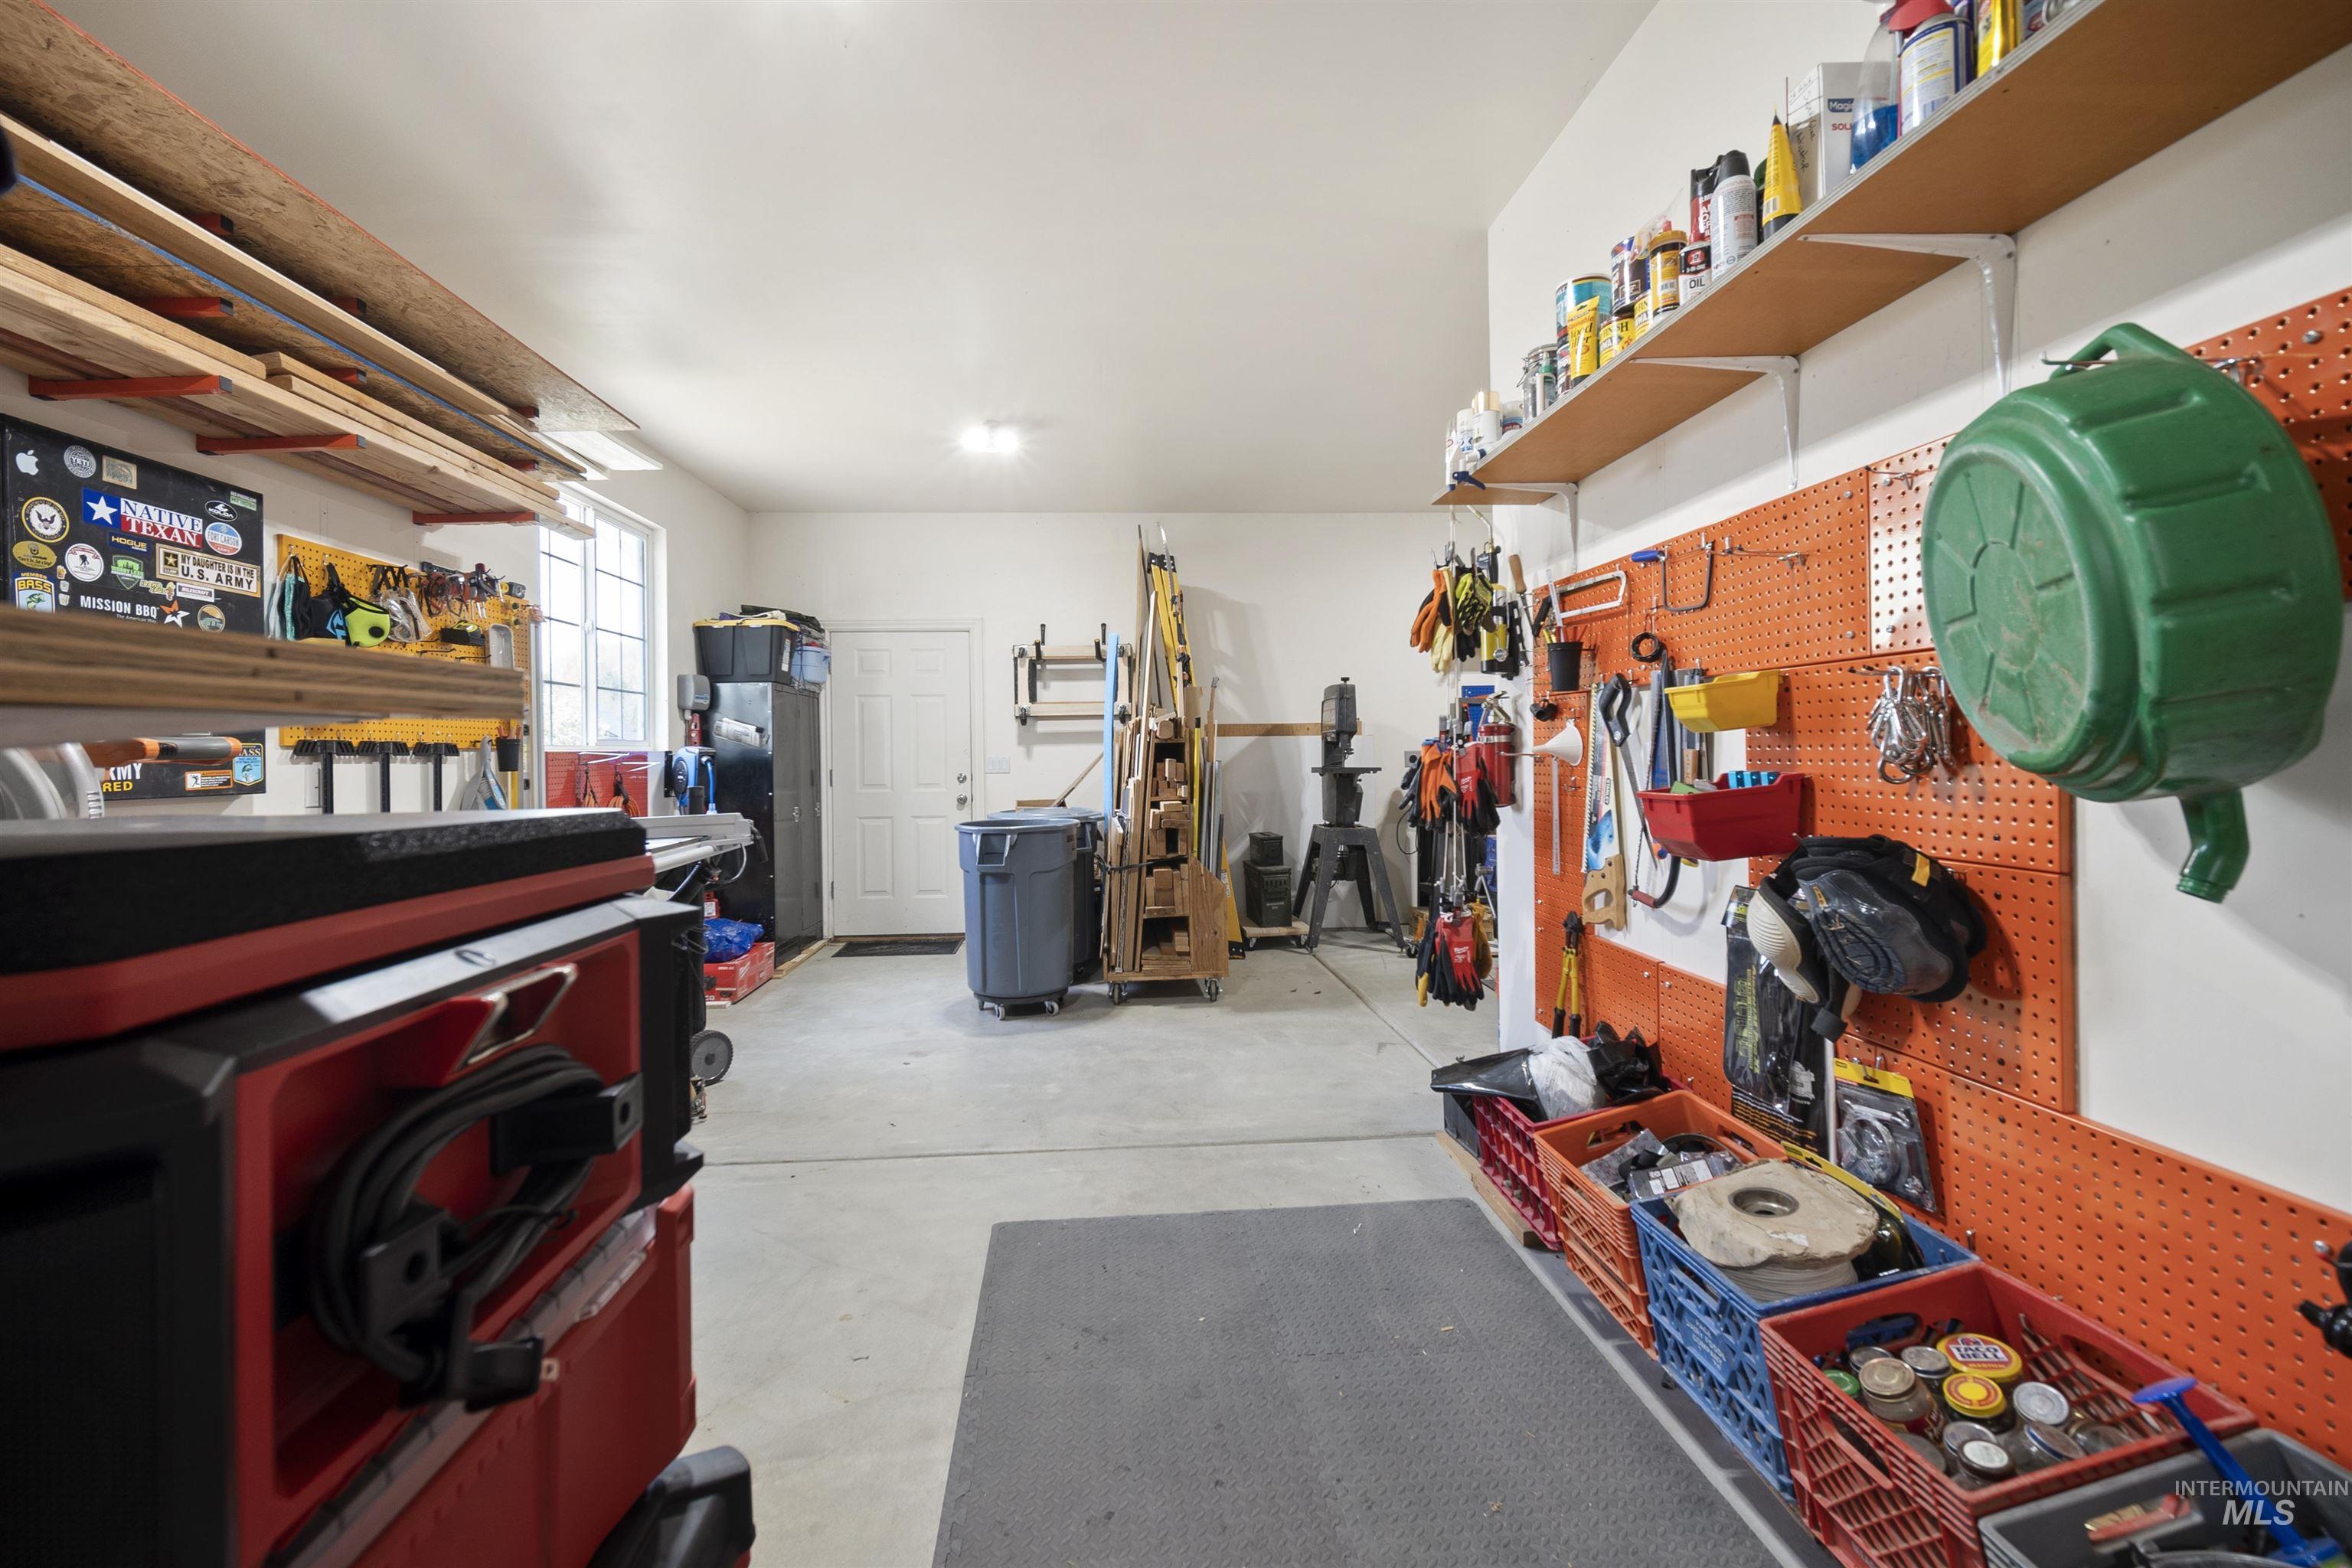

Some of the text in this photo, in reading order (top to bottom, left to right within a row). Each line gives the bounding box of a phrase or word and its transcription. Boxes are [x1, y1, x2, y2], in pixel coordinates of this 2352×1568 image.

[1689, 278, 1706, 289] OIL
[71, 456, 90, 466] YETI
[123, 499, 201, 533] NATIVE
[126, 517, 198, 547] TEXAN
[207, 531, 239, 547] FORT CARSON
[112, 536, 147, 549] HOGUE
[181, 554, 254, 579] MY DAUGHTER IS IN THE
[21, 572, 47, 580] MEMBER
[215, 573, 253, 590] ARMY
[80, 595, 158, 619] MISSION BBQ
[239, 748, 260, 756] ASS
